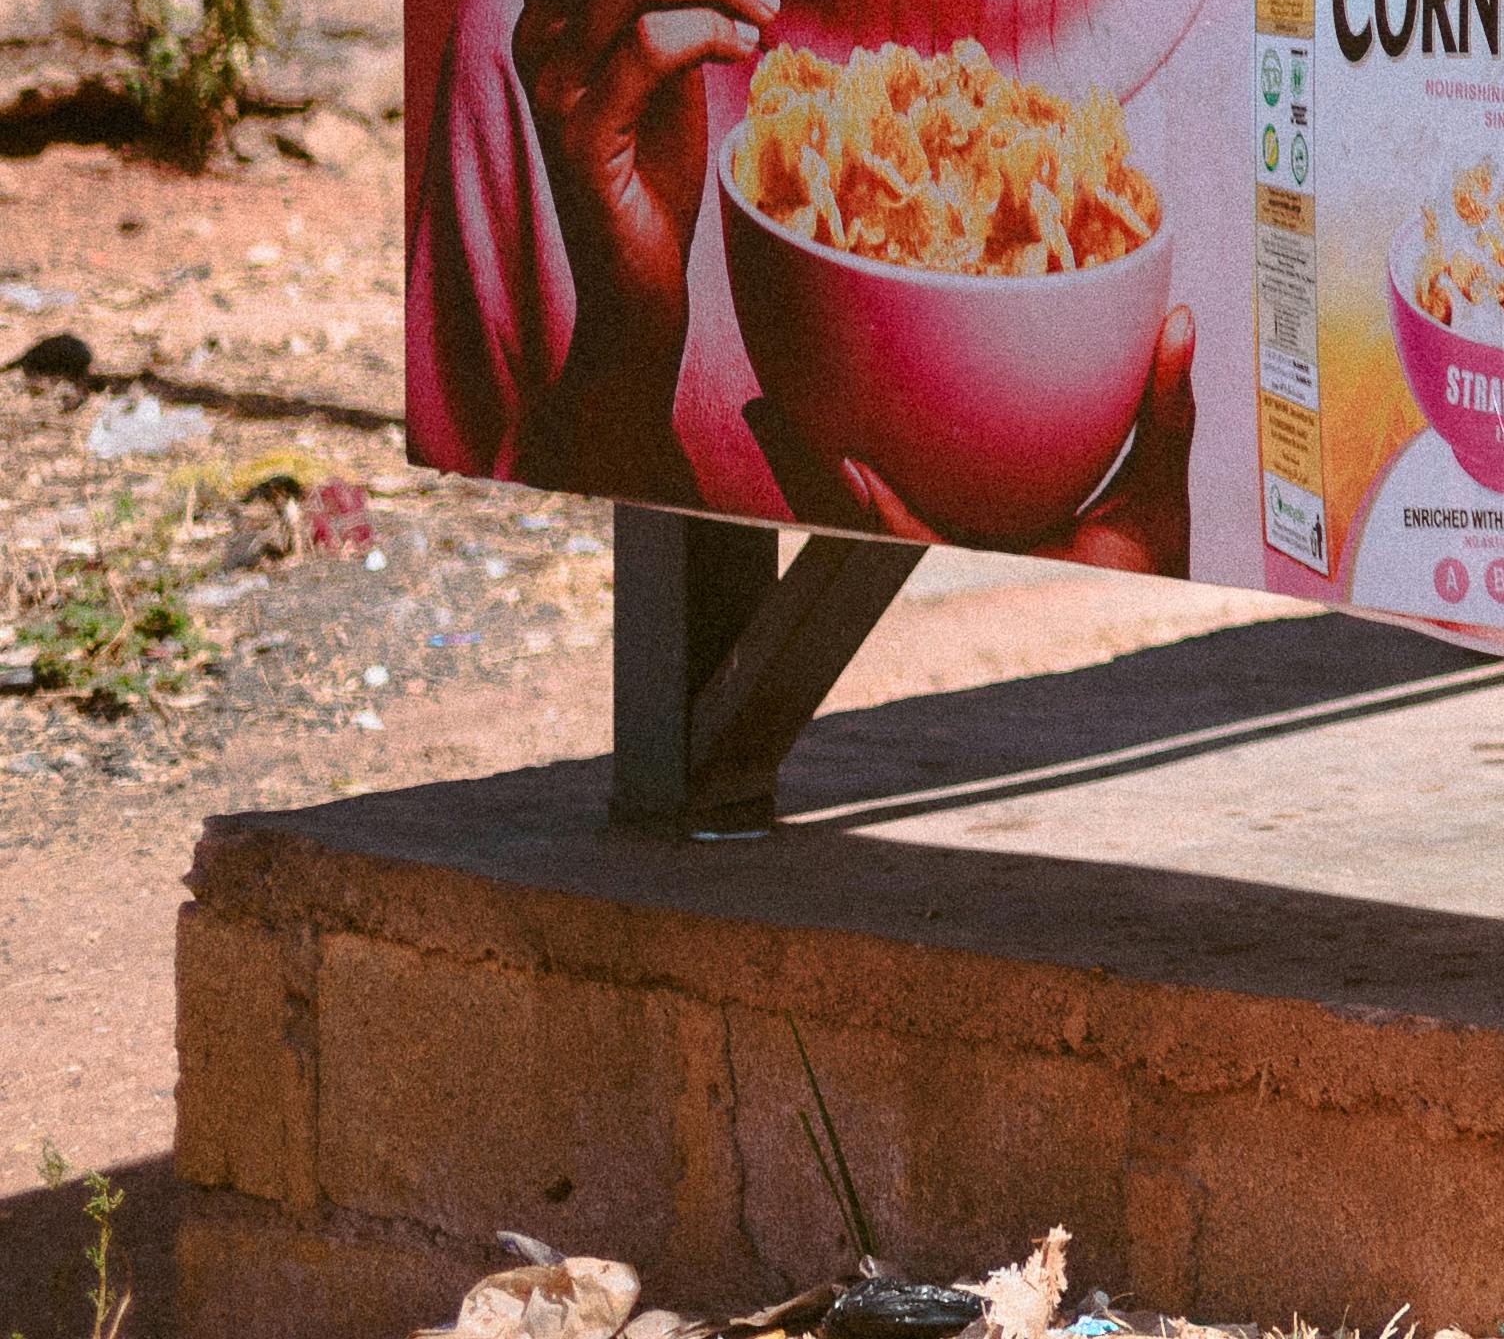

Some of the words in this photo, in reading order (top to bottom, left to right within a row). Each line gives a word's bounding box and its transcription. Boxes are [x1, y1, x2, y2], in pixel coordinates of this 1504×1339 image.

[1404, 508, 1469, 529] ENRICHED
[1471, 509, 1504, 530] WITH
[1445, 566, 1459, 592] A
